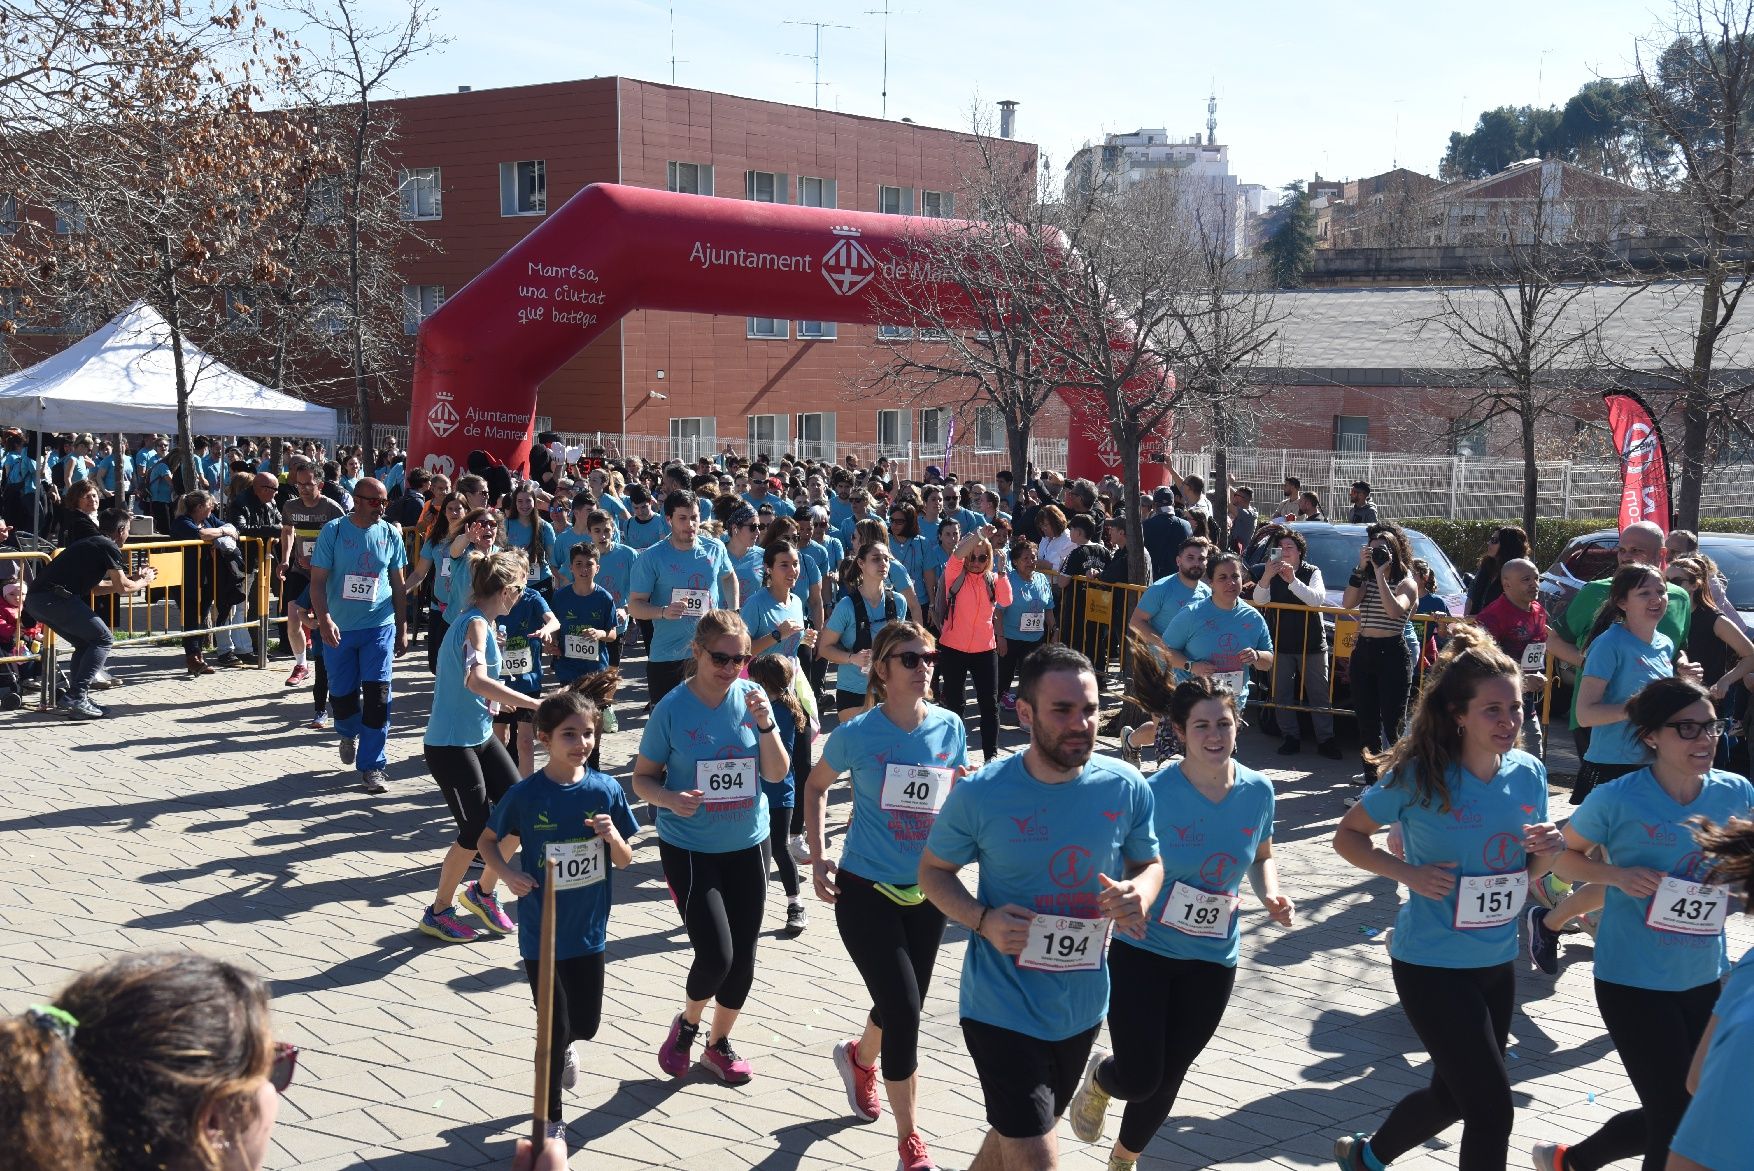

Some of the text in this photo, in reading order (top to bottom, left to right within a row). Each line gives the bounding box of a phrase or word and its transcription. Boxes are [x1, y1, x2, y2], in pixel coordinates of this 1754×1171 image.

[690, 241, 812, 273] Ajuntament
[528, 262, 599, 283] Manresa,
[882, 257, 907, 279] de
[519, 285, 606, 304] una ciutat
[518, 306, 597, 328] que batega
[466, 406, 530, 424] Ajuntament
[464, 424, 528, 440] de Manresa
[350, 583, 373, 595] 557
[569, 643, 595, 655] 1060
[501, 657, 528, 670] 1056
[709, 772, 744, 791] 694
[903, 781, 930, 801] 40
[555, 854, 599, 878] 1021
[1476, 891, 1513, 912] 151
[1670, 898, 1718, 920] 437
[1184, 903, 1220, 924] 193
[1043, 932, 1090, 957] 194
